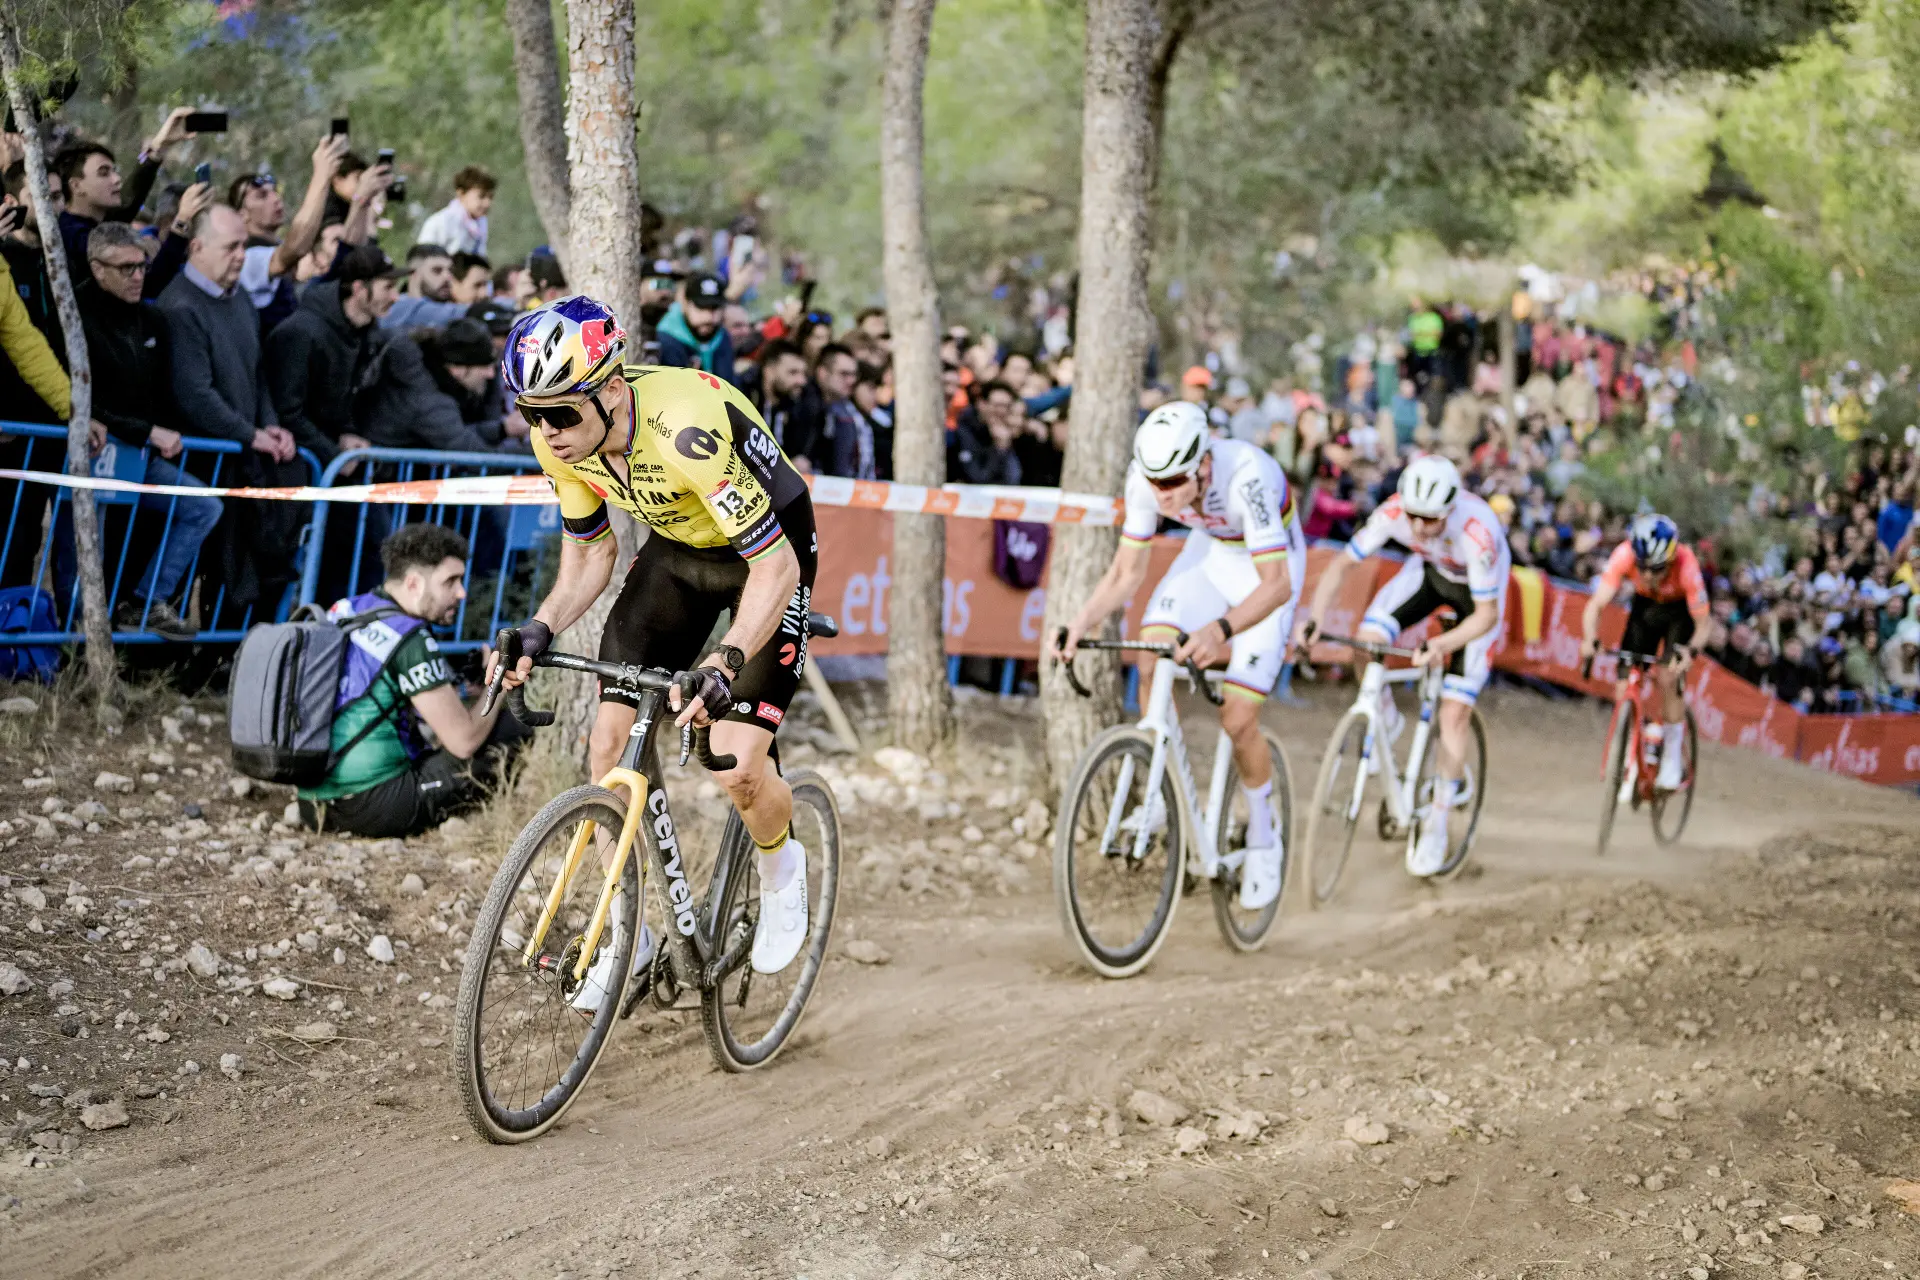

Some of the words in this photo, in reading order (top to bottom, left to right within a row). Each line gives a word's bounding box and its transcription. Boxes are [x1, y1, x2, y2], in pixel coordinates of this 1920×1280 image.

[647, 411, 673, 438] ethias
[749, 427, 780, 468] CAPS
[717, 490, 745, 517] 13
[735, 491, 764, 520] CAPS
[793, 635, 808, 680] lease
[801, 585, 812, 619] bike
